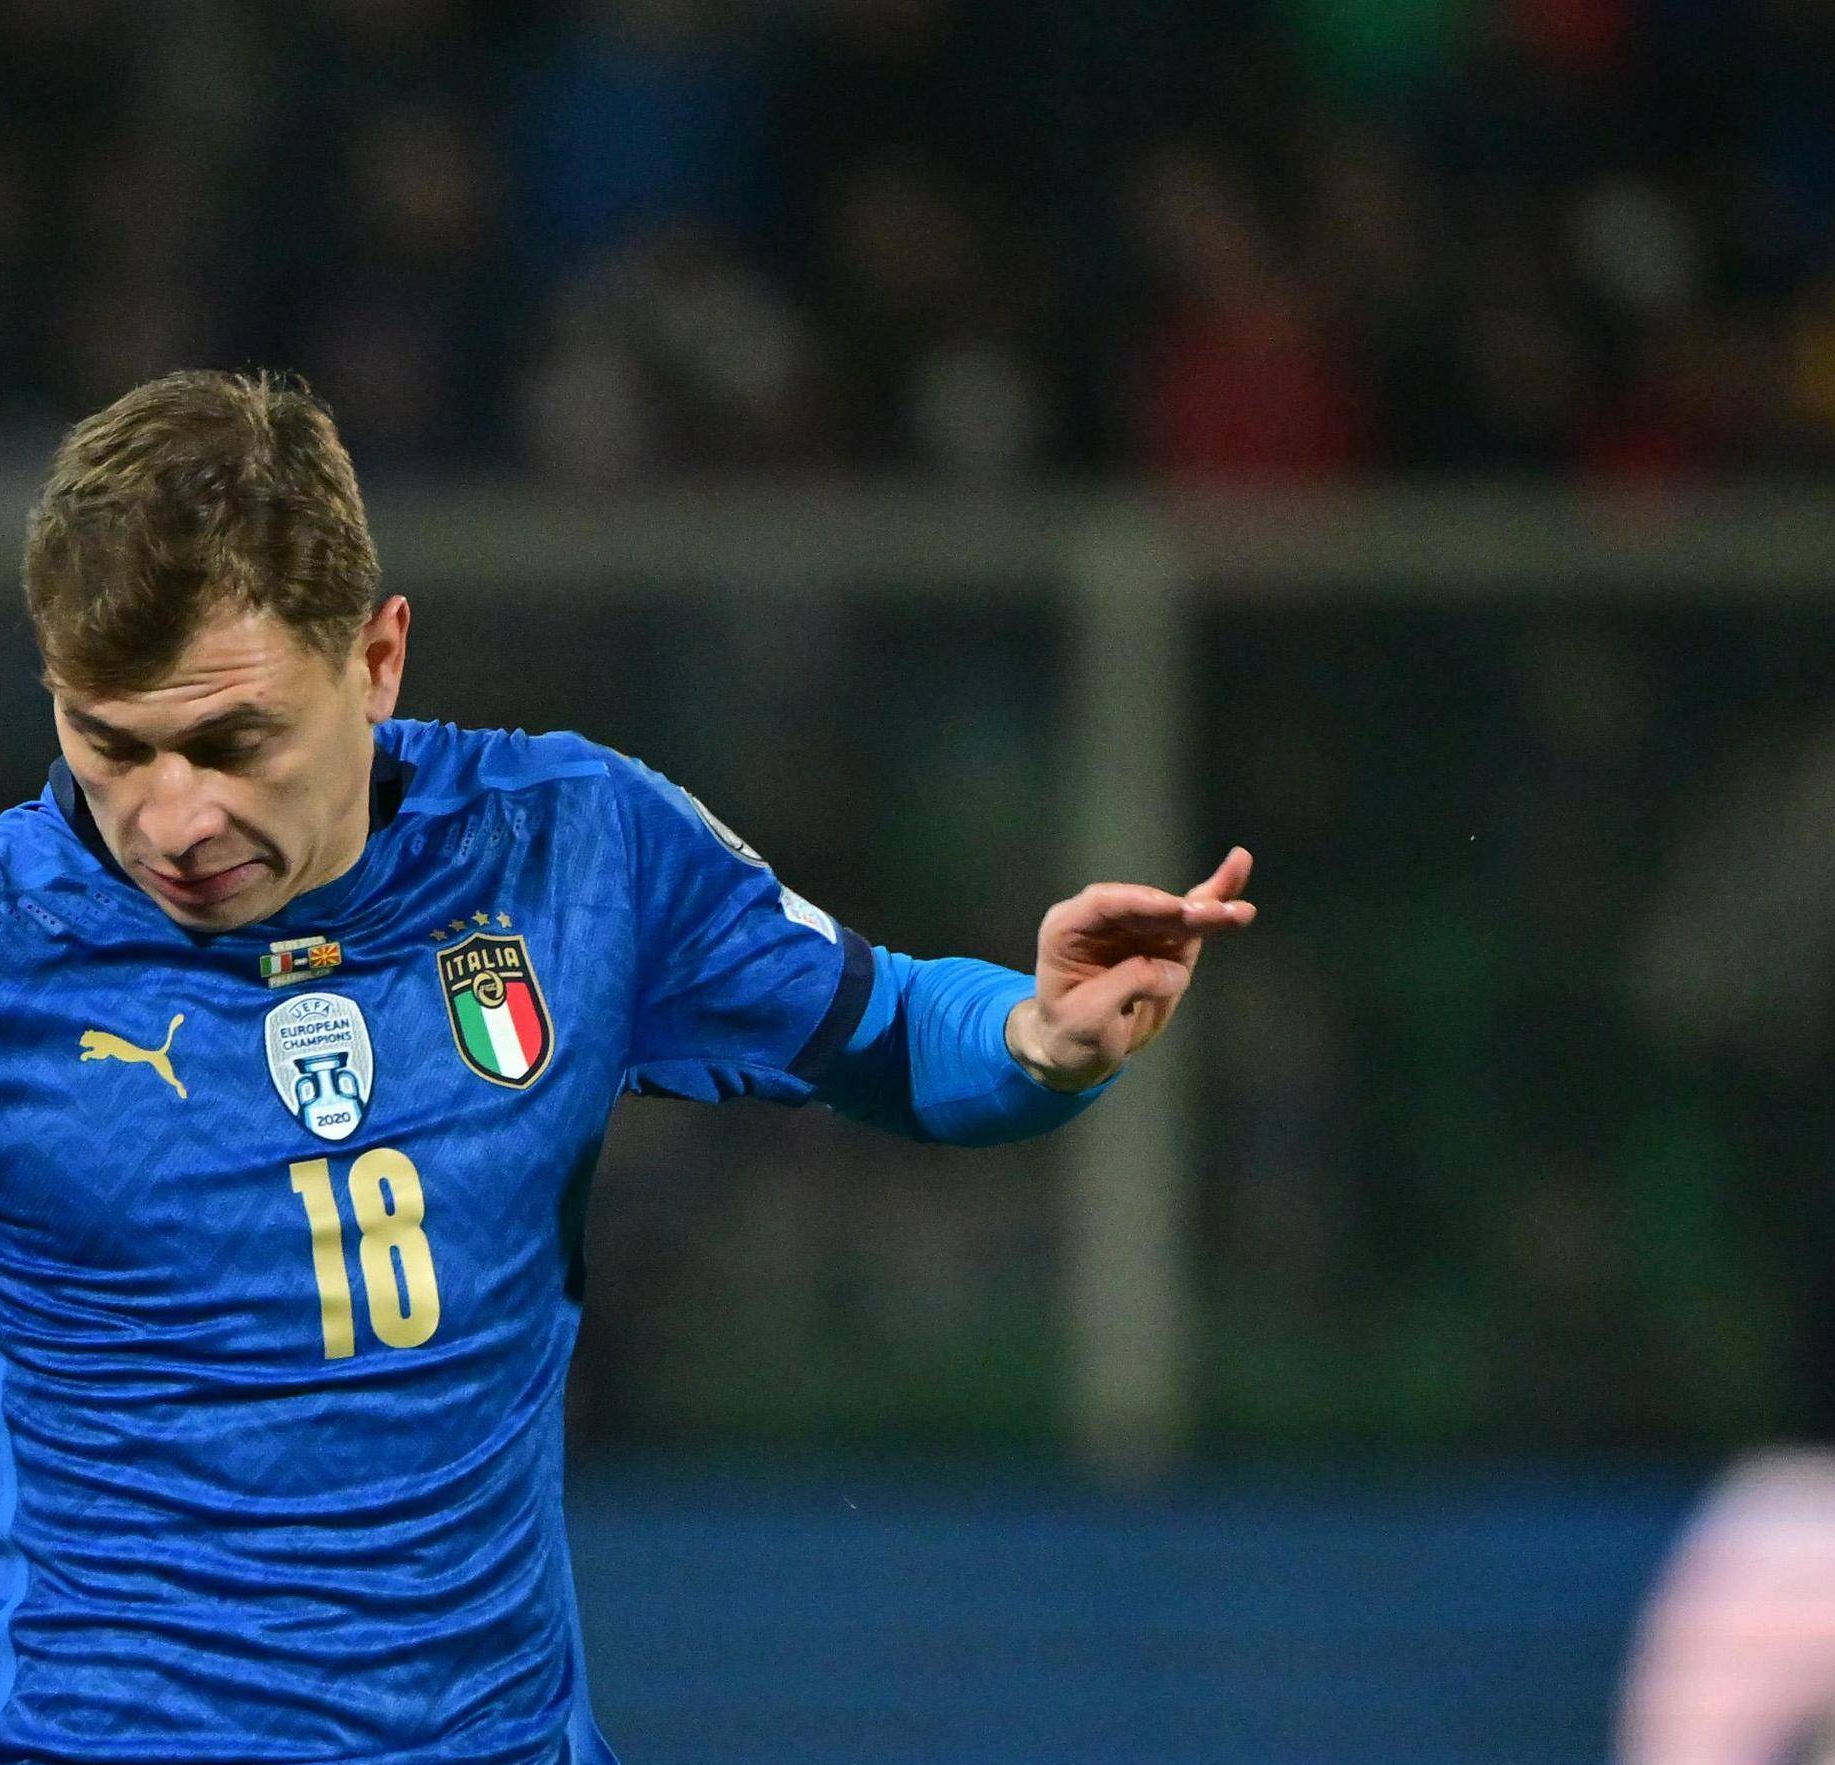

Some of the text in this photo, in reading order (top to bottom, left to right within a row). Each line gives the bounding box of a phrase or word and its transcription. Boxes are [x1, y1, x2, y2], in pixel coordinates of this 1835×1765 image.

[445, 947, 520, 981] ITALIA
[280, 1018, 350, 1039] EUROPEAN
[282, 1031, 353, 1051] CHAMPIONS
[316, 1112, 352, 1127] 2020
[288, 1147, 441, 1360] 18
